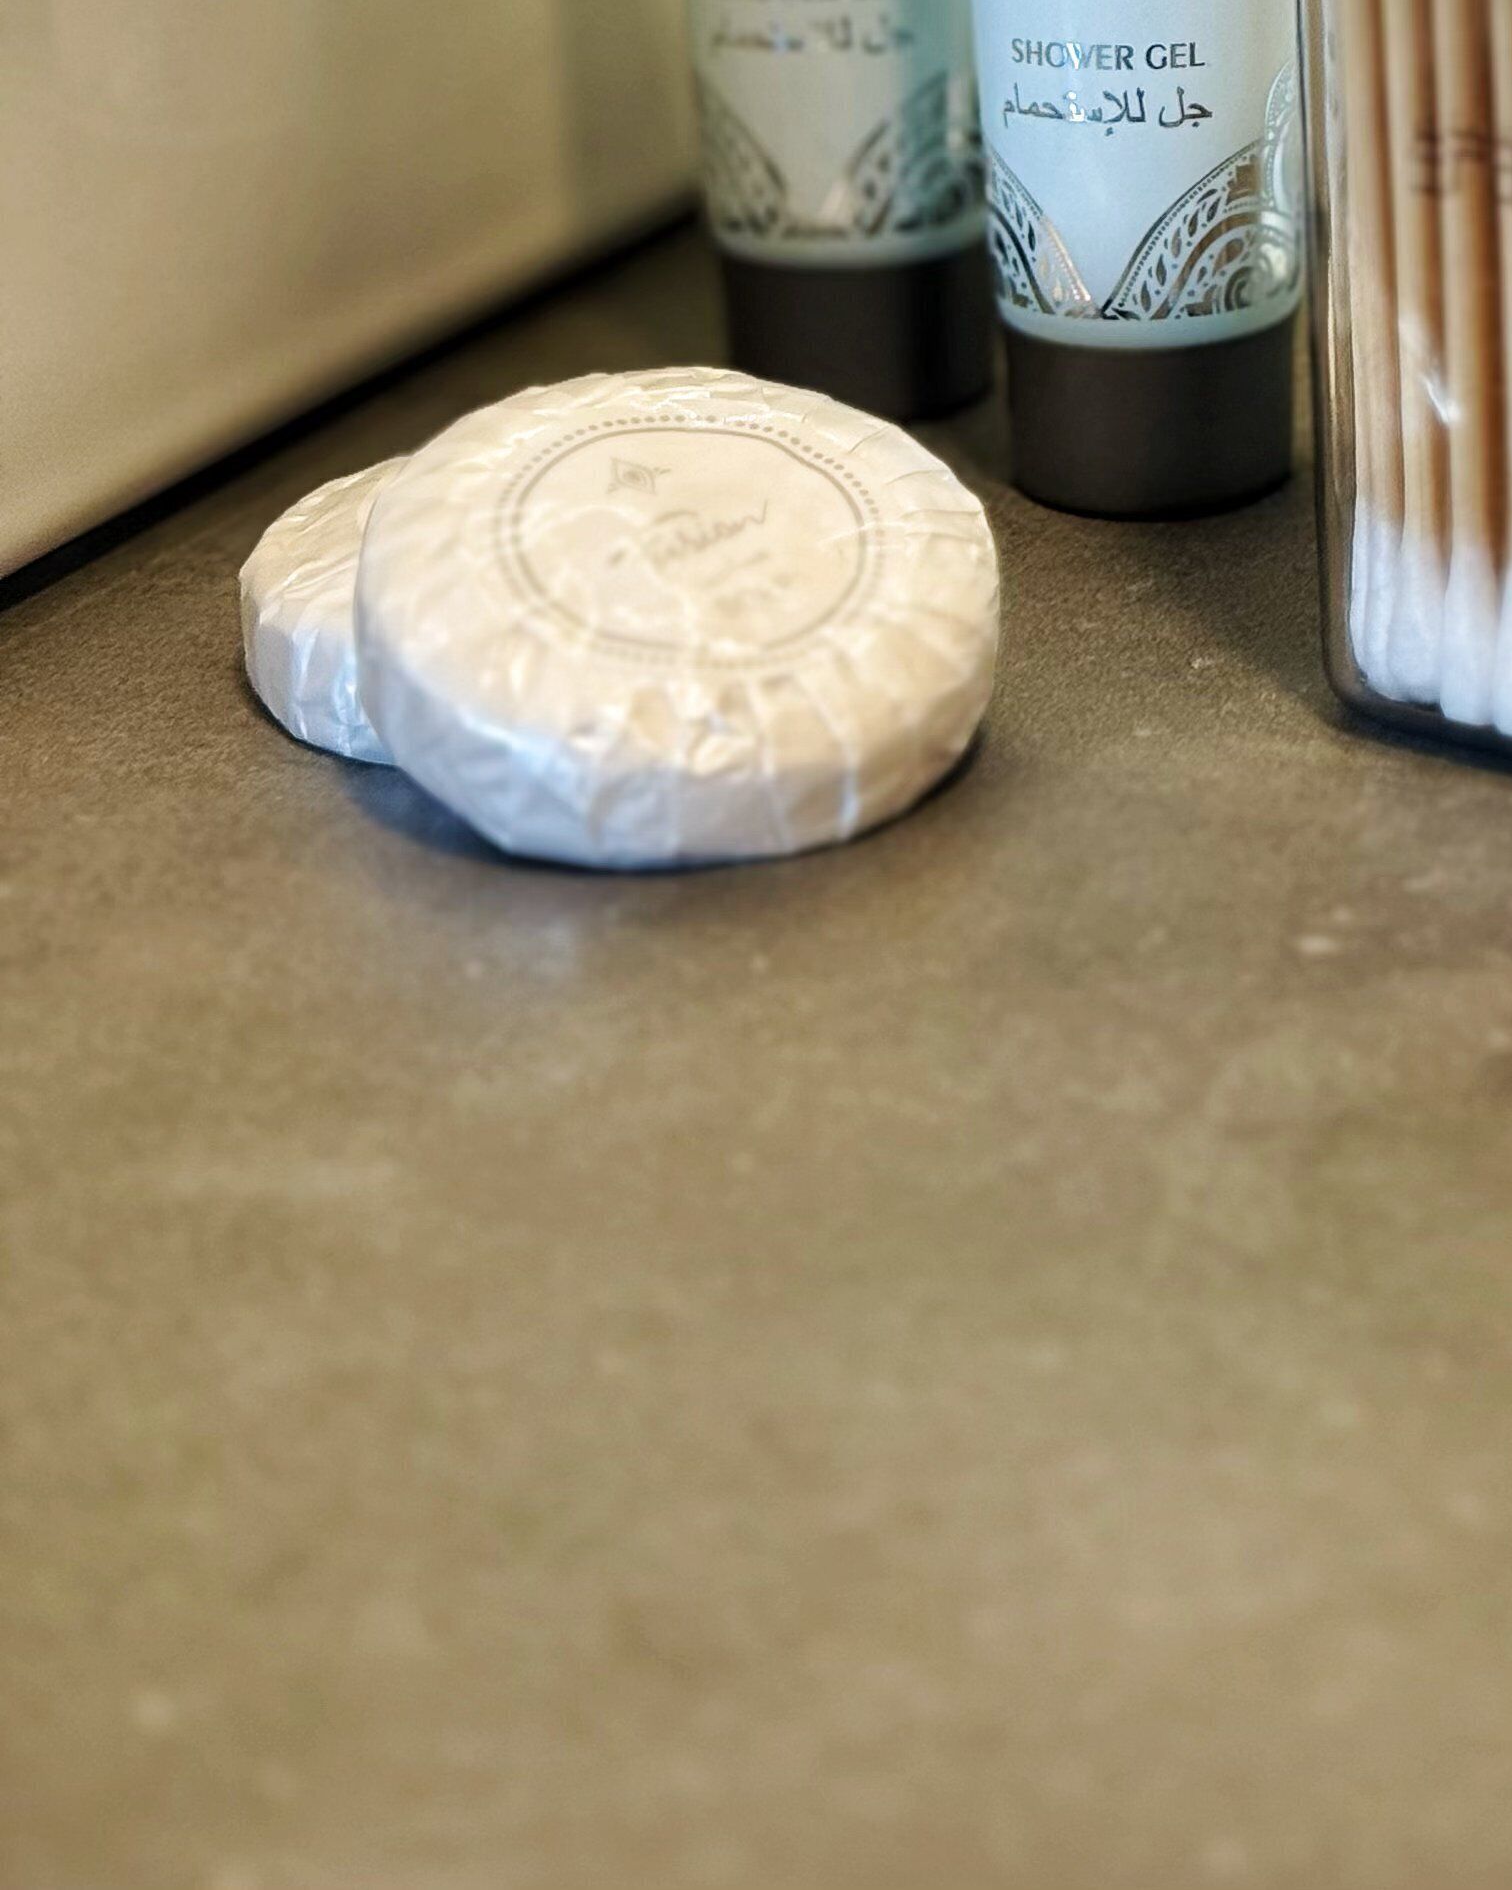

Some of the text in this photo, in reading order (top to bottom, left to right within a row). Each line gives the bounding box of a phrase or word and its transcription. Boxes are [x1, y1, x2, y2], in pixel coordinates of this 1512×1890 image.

[1010, 37, 1207, 72] SHOWER GEL
[1157, 84, 1214, 129] جل
